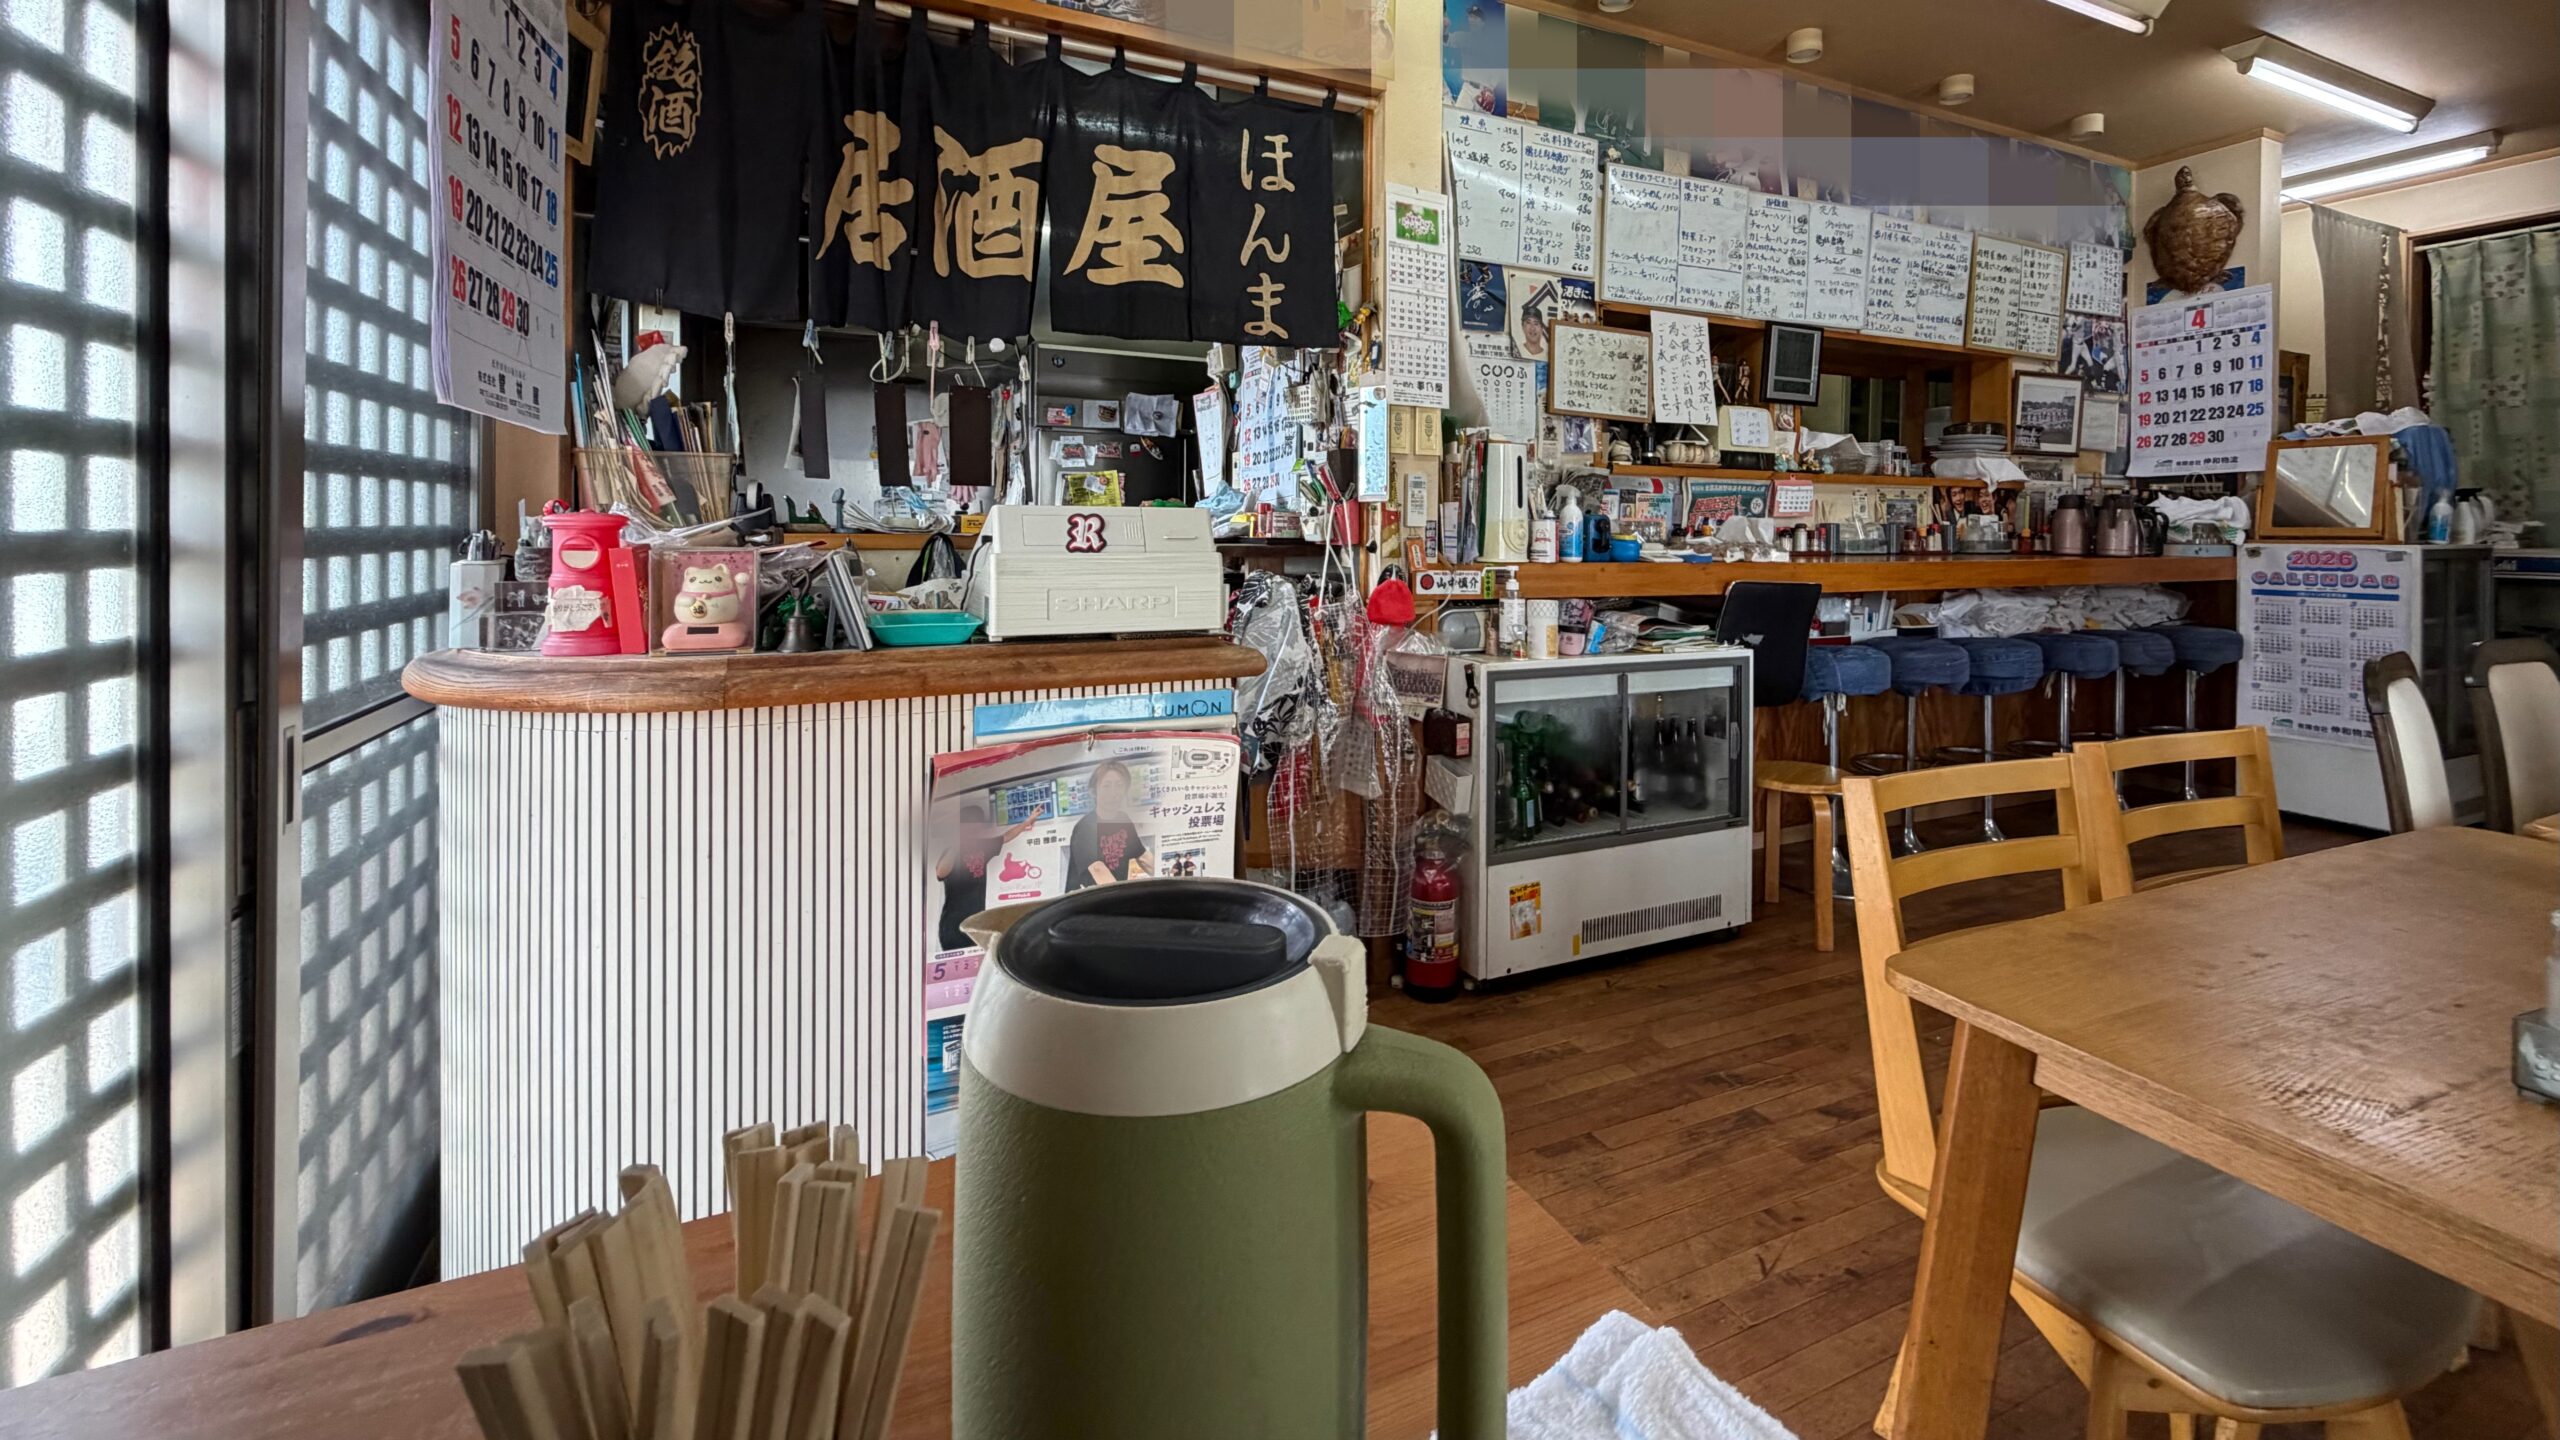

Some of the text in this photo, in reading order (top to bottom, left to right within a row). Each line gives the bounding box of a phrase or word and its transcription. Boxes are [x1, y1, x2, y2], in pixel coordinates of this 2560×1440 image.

[504, 10, 557, 100] 1 2 3 4
[451, 14, 558, 165] 5 6 7 8 9 10 11
[648, 38, 697, 136] 銘酒
[1500, 141, 1517, 154] 550
[447, 93, 557, 226] 12 13 14 15 16 17 18
[1499, 160, 1517, 171] 650
[816, 110, 1185, 289] 居酒屋
[448, 174, 558, 288] 19 20 21 22 23 24 25
[1239, 128, 1296, 340] ほんま
[1572, 221, 1591, 233] 1600
[1572, 263, 1589, 272] 660
[451, 254, 530, 337] 26 27 28 29 30
[2191, 308, 2206, 329] 4
[2196, 332, 2261, 352] 1 2 3 4
[1517, 366, 1528, 379] ふ
[2141, 354, 2263, 382] 5 6 7 8 9 10 11
[2138, 378, 2263, 405] 12 13 14 15 16 17 18
[2138, 402, 2264, 427] 19 20 21 22 23 24 25
[2136, 429, 2224, 449] 26 27 28 29 30
[1069, 515, 1104, 550] R
[2287, 550, 2358, 571] 2026
[2251, 571, 2400, 589] CALENDAR
[1055, 594, 1171, 612] SHARP
[1149, 801, 1226, 818] キャッシュレス
[1188, 814, 1225, 829] 投票場
[933, 962, 947, 981] 5
[964, 963, 969, 971] 2
